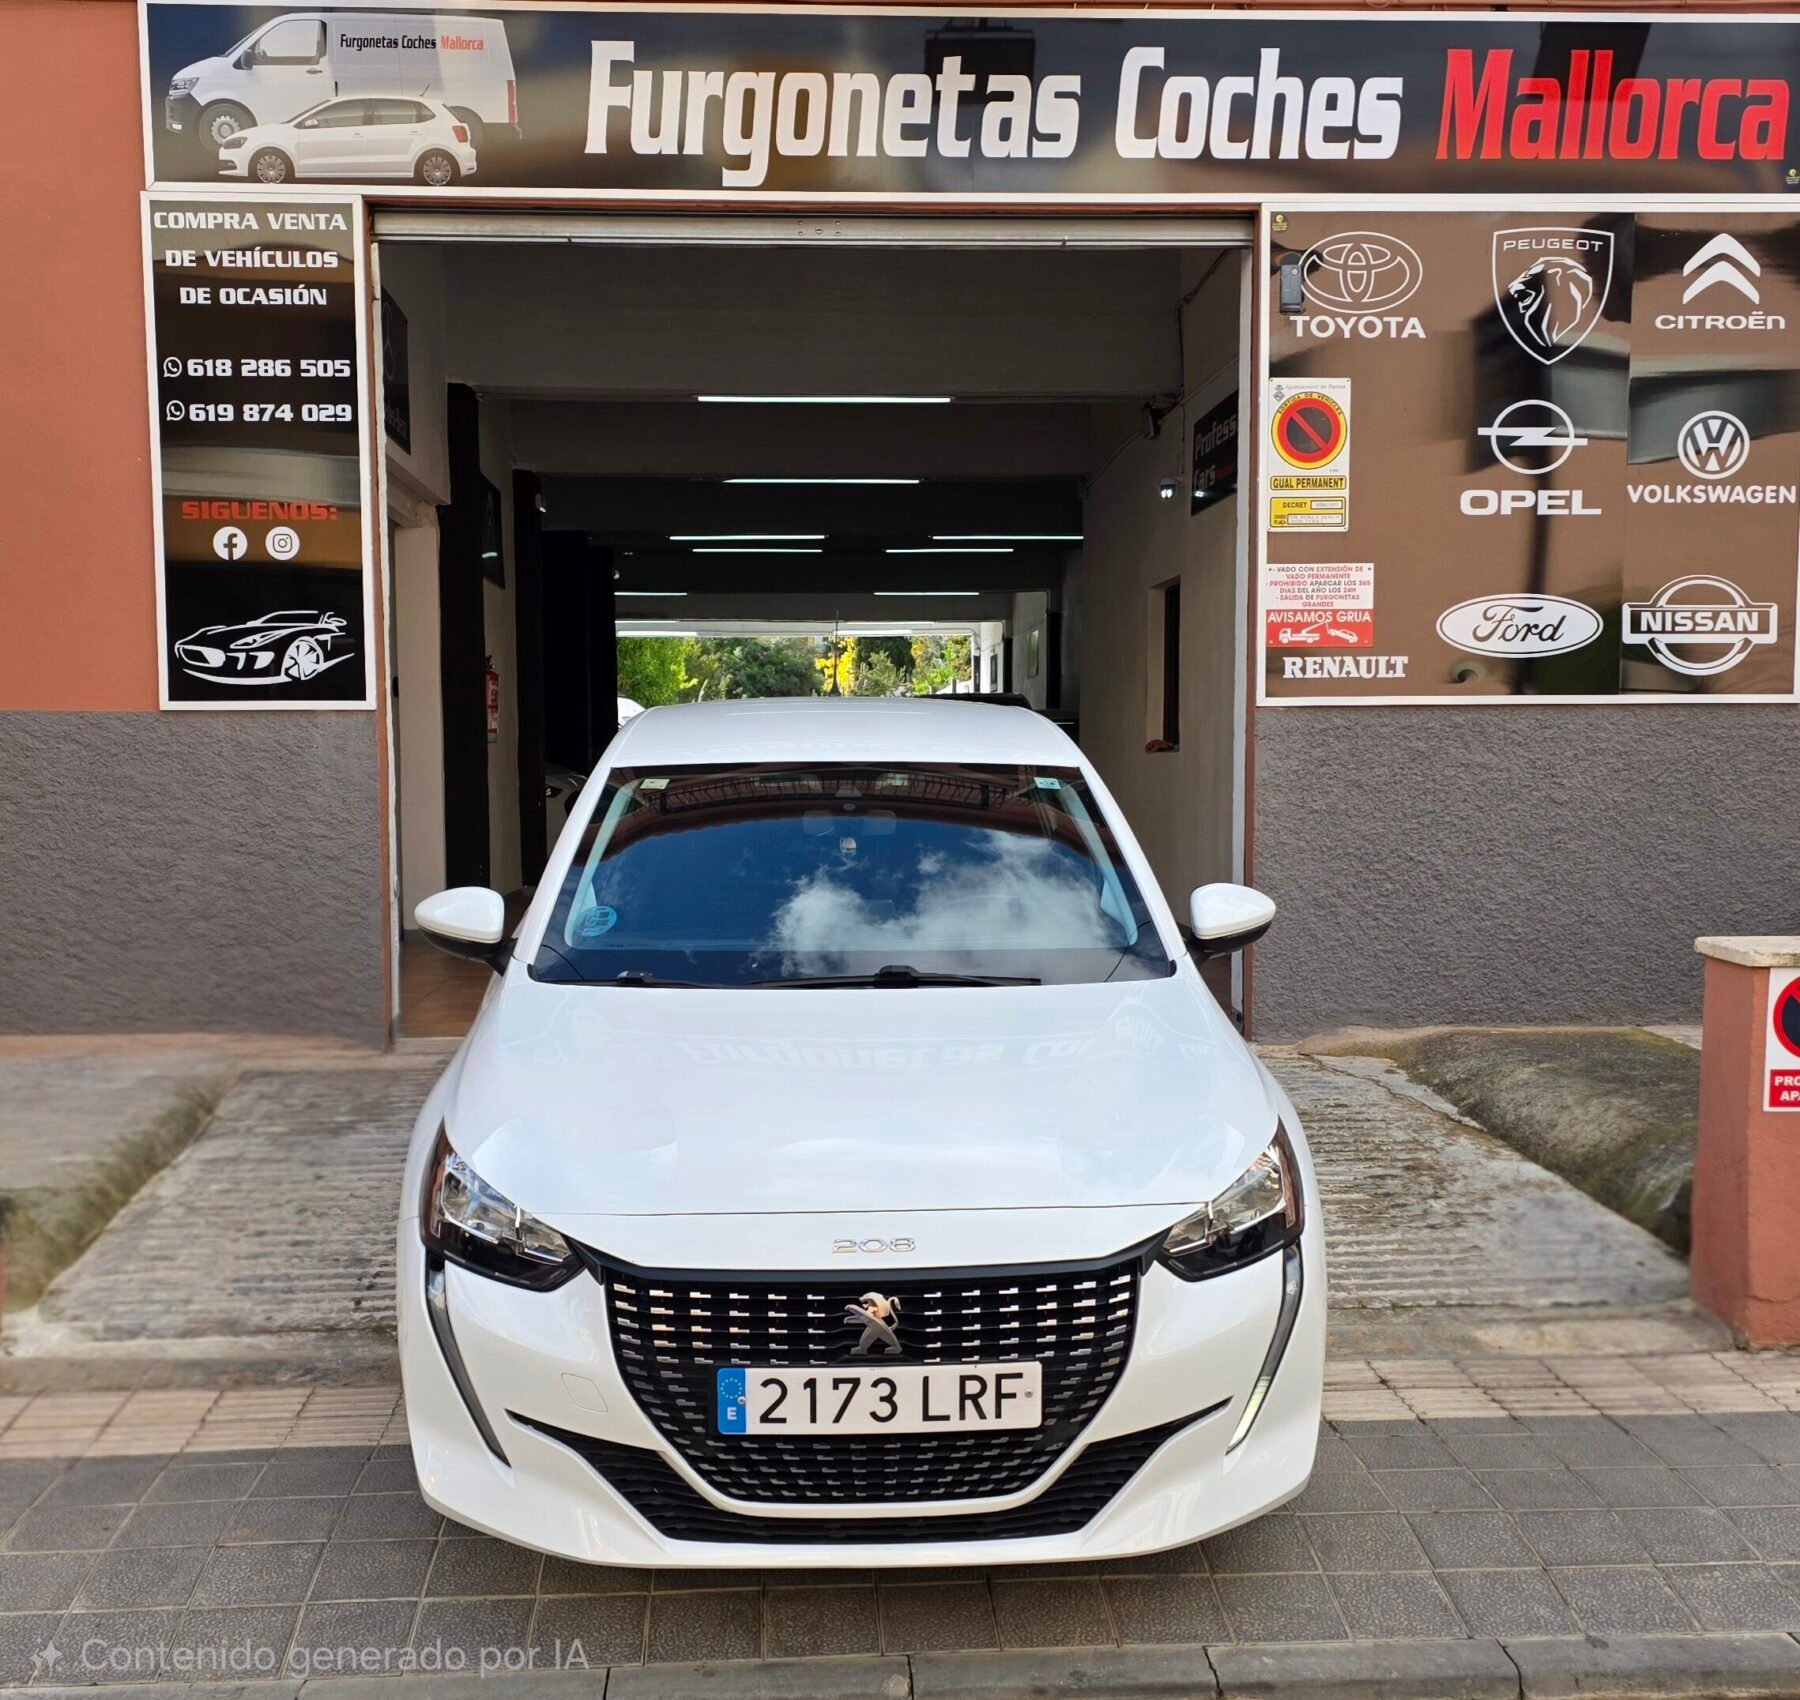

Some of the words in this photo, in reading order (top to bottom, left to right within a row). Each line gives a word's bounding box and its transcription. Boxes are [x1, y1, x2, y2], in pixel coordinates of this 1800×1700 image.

[340, 33, 398, 51] Furgonetas
[401, 35, 436, 49] Coches
[440, 36, 484, 50] Mallorca
[584, 40, 1081, 187] Furgonetas
[1115, 46, 1404, 160] Coches
[1435, 48, 1791, 160] Mallorca
[154, 212, 260, 229] COMPRA
[267, 213, 348, 230] VENTA
[1503, 239, 1603, 252] PEUGEOT
[165, 250, 197, 267] DE
[204, 246, 338, 268] VEHÍCULOS
[180, 287, 211, 304] DE
[220, 284, 327, 306] OCASIÓN
[1290, 316, 1426, 338] TOYOTA
[187, 359, 232, 377] 618
[241, 359, 291, 377] 286
[300, 360, 350, 377] 505
[189, 404, 234, 422] 619
[242, 404, 294, 422] 874
[302, 404, 352, 422] 029
[1273, 478, 1294, 488] GUAL
[1296, 478, 1344, 488] PERMANENT
[1460, 490, 1602, 515] OPEL
[1627, 485, 1796, 504] VOLKSWAGEN
[182, 502, 337, 521] SIGUENOS:
[1268, 611, 1332, 622] AVISAMOS
[1336, 611, 1372, 622] GRUA
[1472, 604, 1567, 642] Ford
[1640, 612, 1759, 632] NISSAN
[1283, 656, 1408, 678] RENAULT
[1780, 1091, 1800, 1101] AP
[832, 1237, 916, 1253] 208
[760, 1378, 898, 1424] 2173
[922, 1372, 1024, 1422] LRF
[727, 1407, 737, 1420] E
